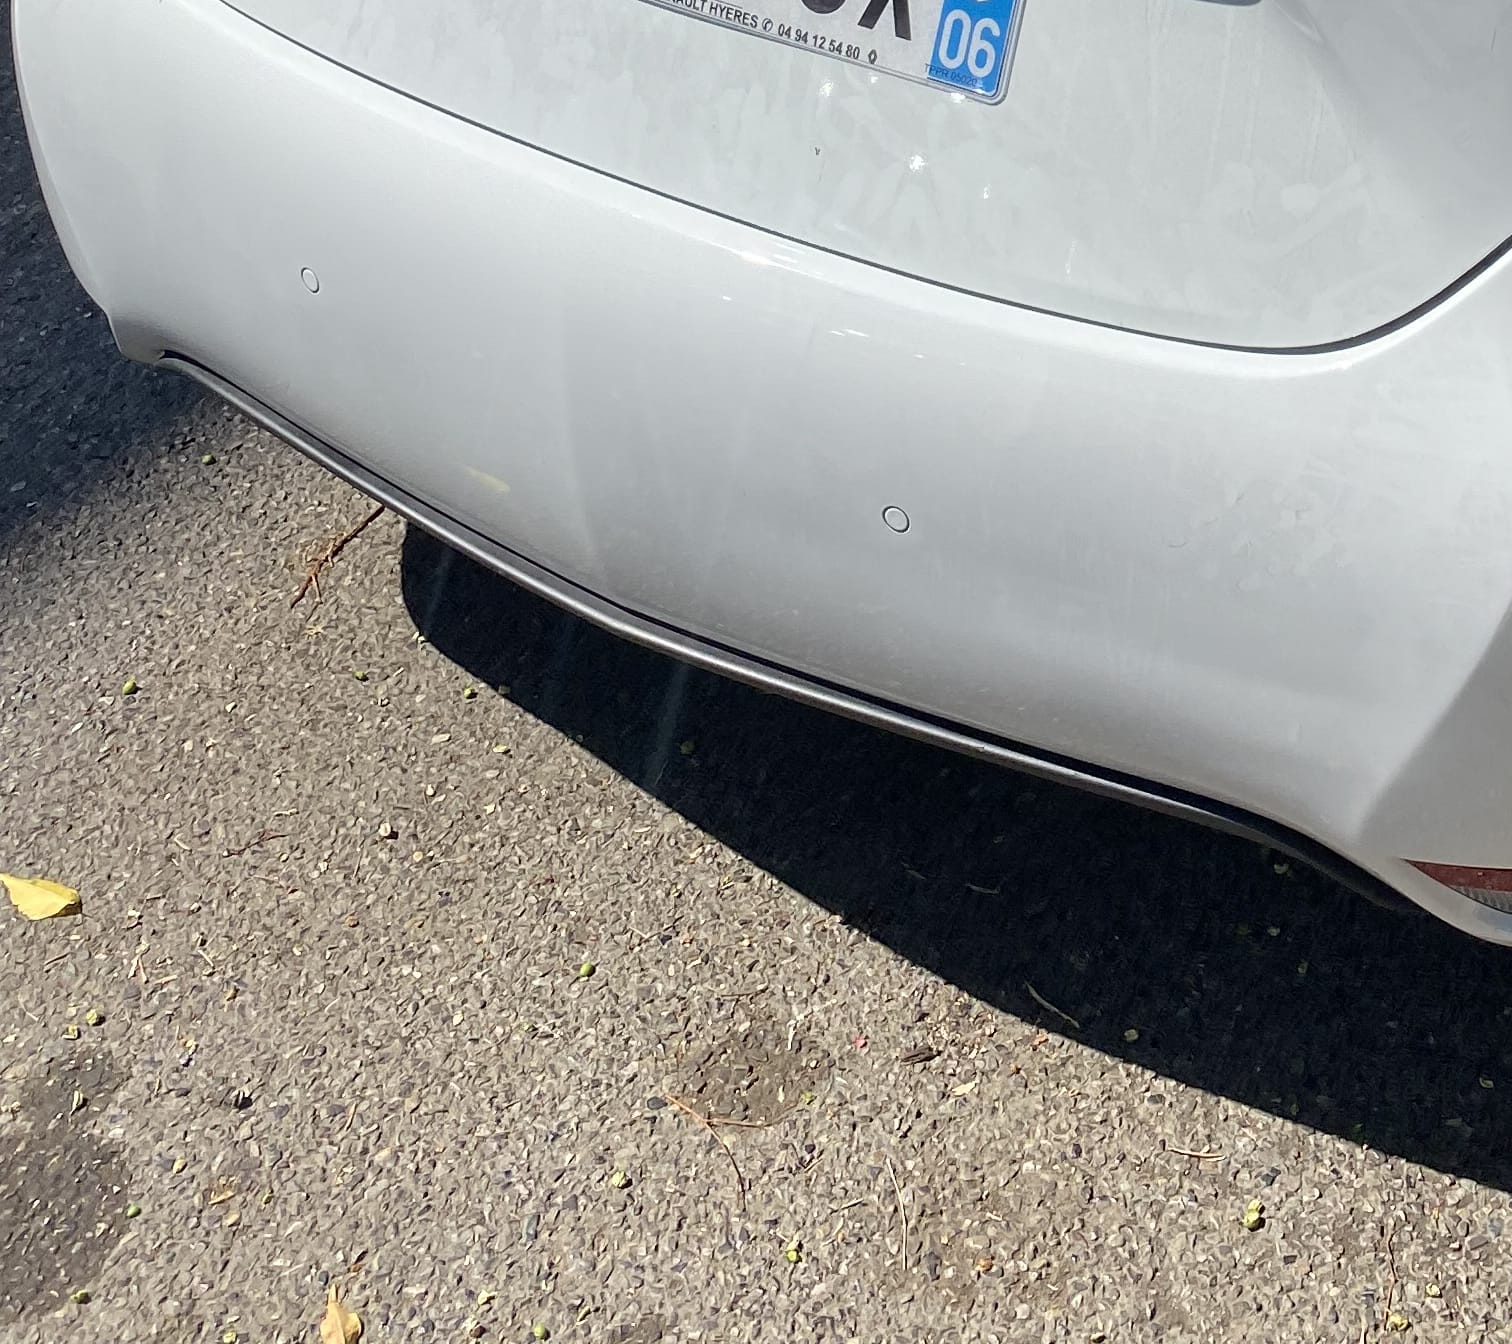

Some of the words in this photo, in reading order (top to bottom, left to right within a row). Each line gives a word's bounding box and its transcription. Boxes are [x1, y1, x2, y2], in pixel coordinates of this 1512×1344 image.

[709, 2, 759, 28] HYERES
[778, 23, 791, 39] 04
[795, 28, 808, 44] 94
[812, 34, 825, 49] 12
[828, 39, 842, 55] 54
[845, 44, 860, 60] 80
[939, 9, 1000, 78] 06
